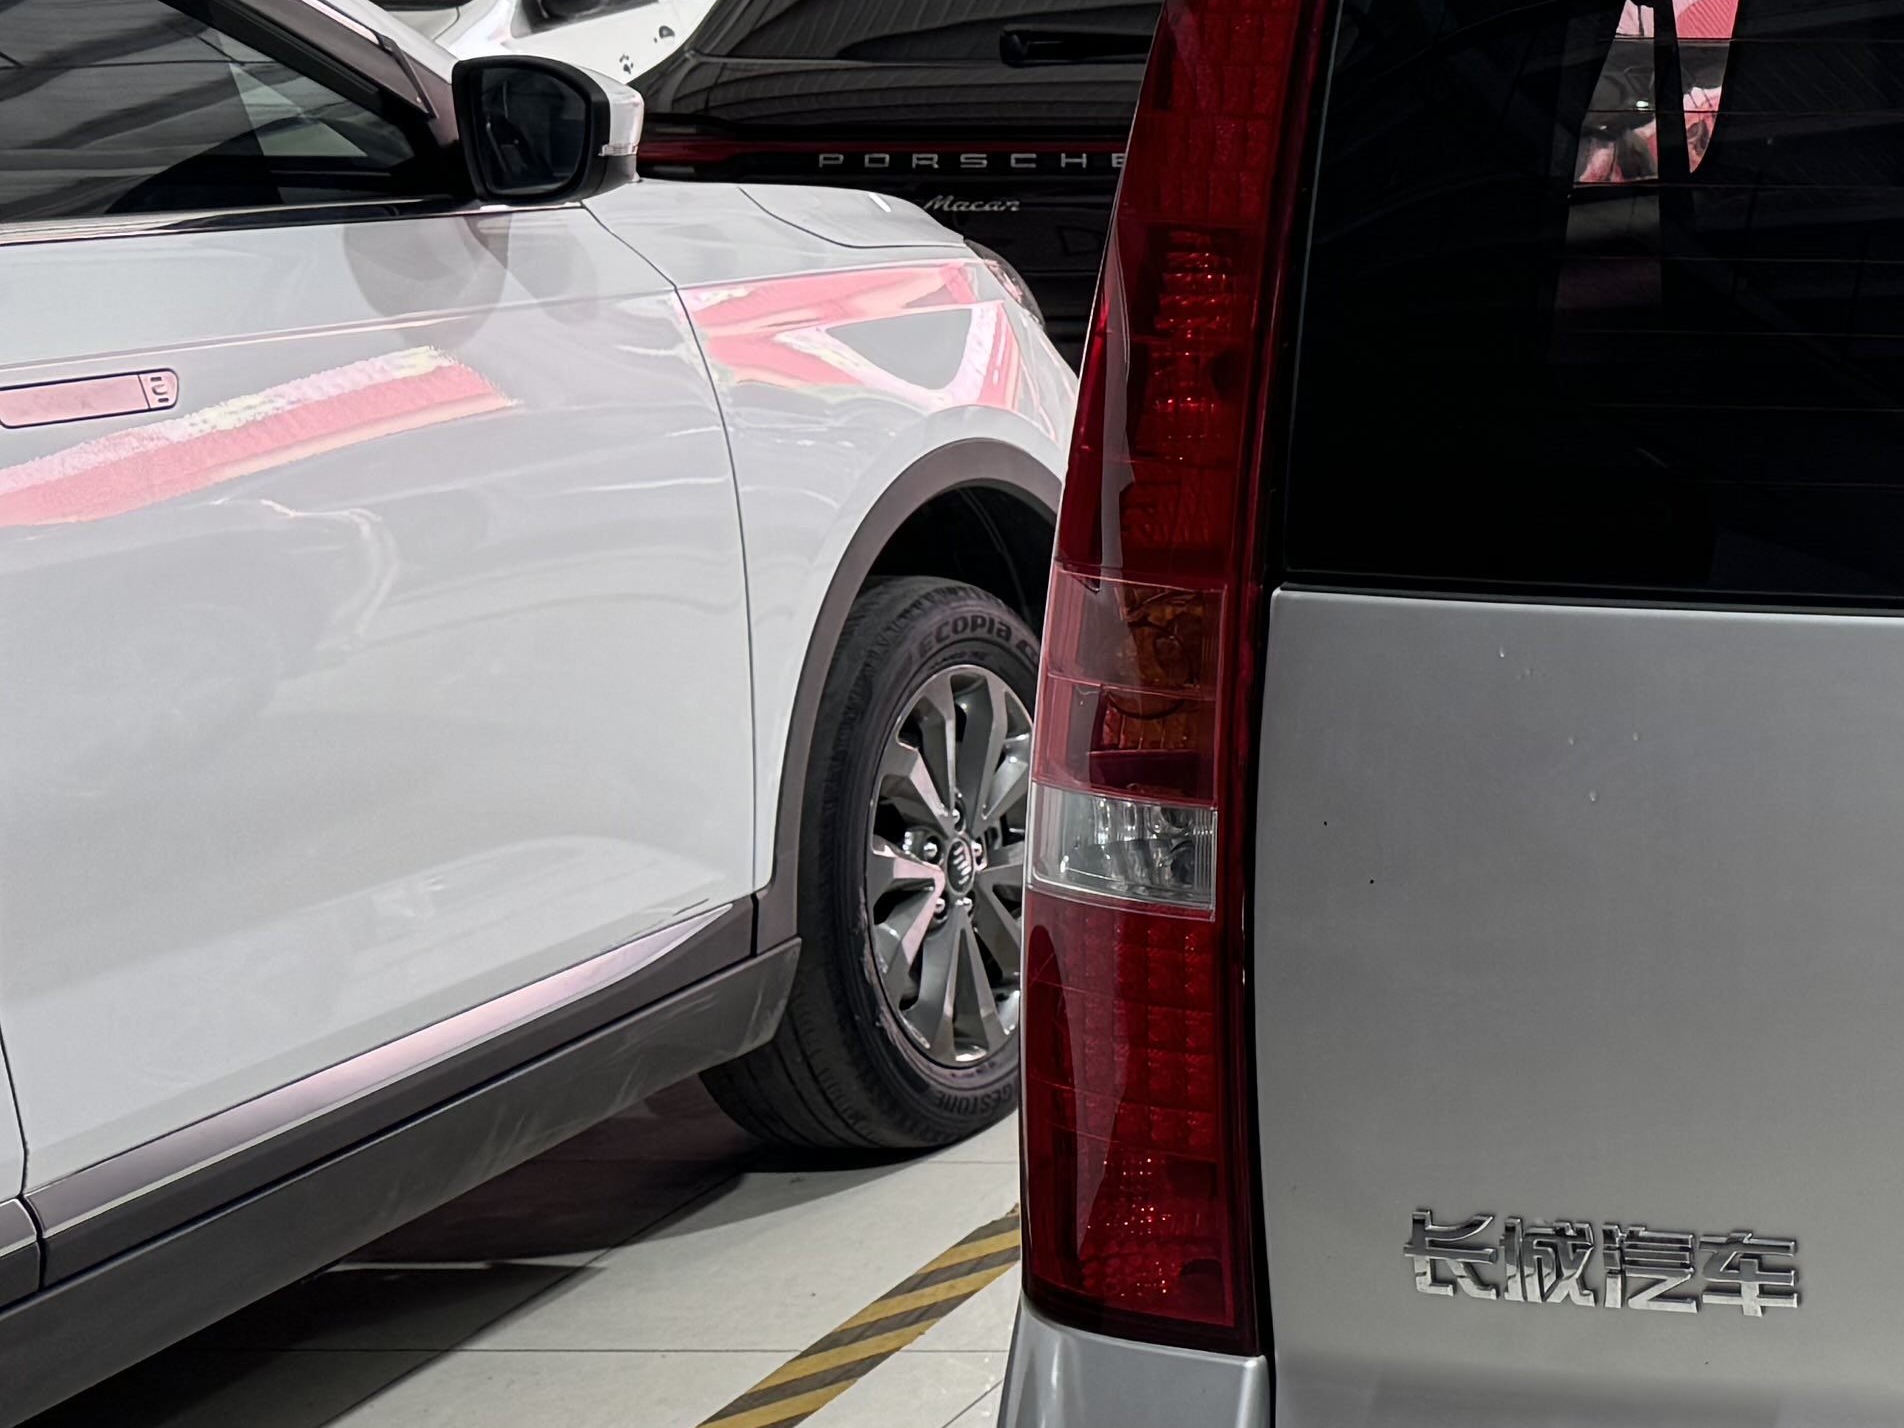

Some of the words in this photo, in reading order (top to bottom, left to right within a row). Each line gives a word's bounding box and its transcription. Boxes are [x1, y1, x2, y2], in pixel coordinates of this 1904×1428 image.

[818, 153, 1128, 169] PORSCHE
[923, 194, 1021, 213] Macan
[1403, 1208, 1799, 1318] 长城汽车
